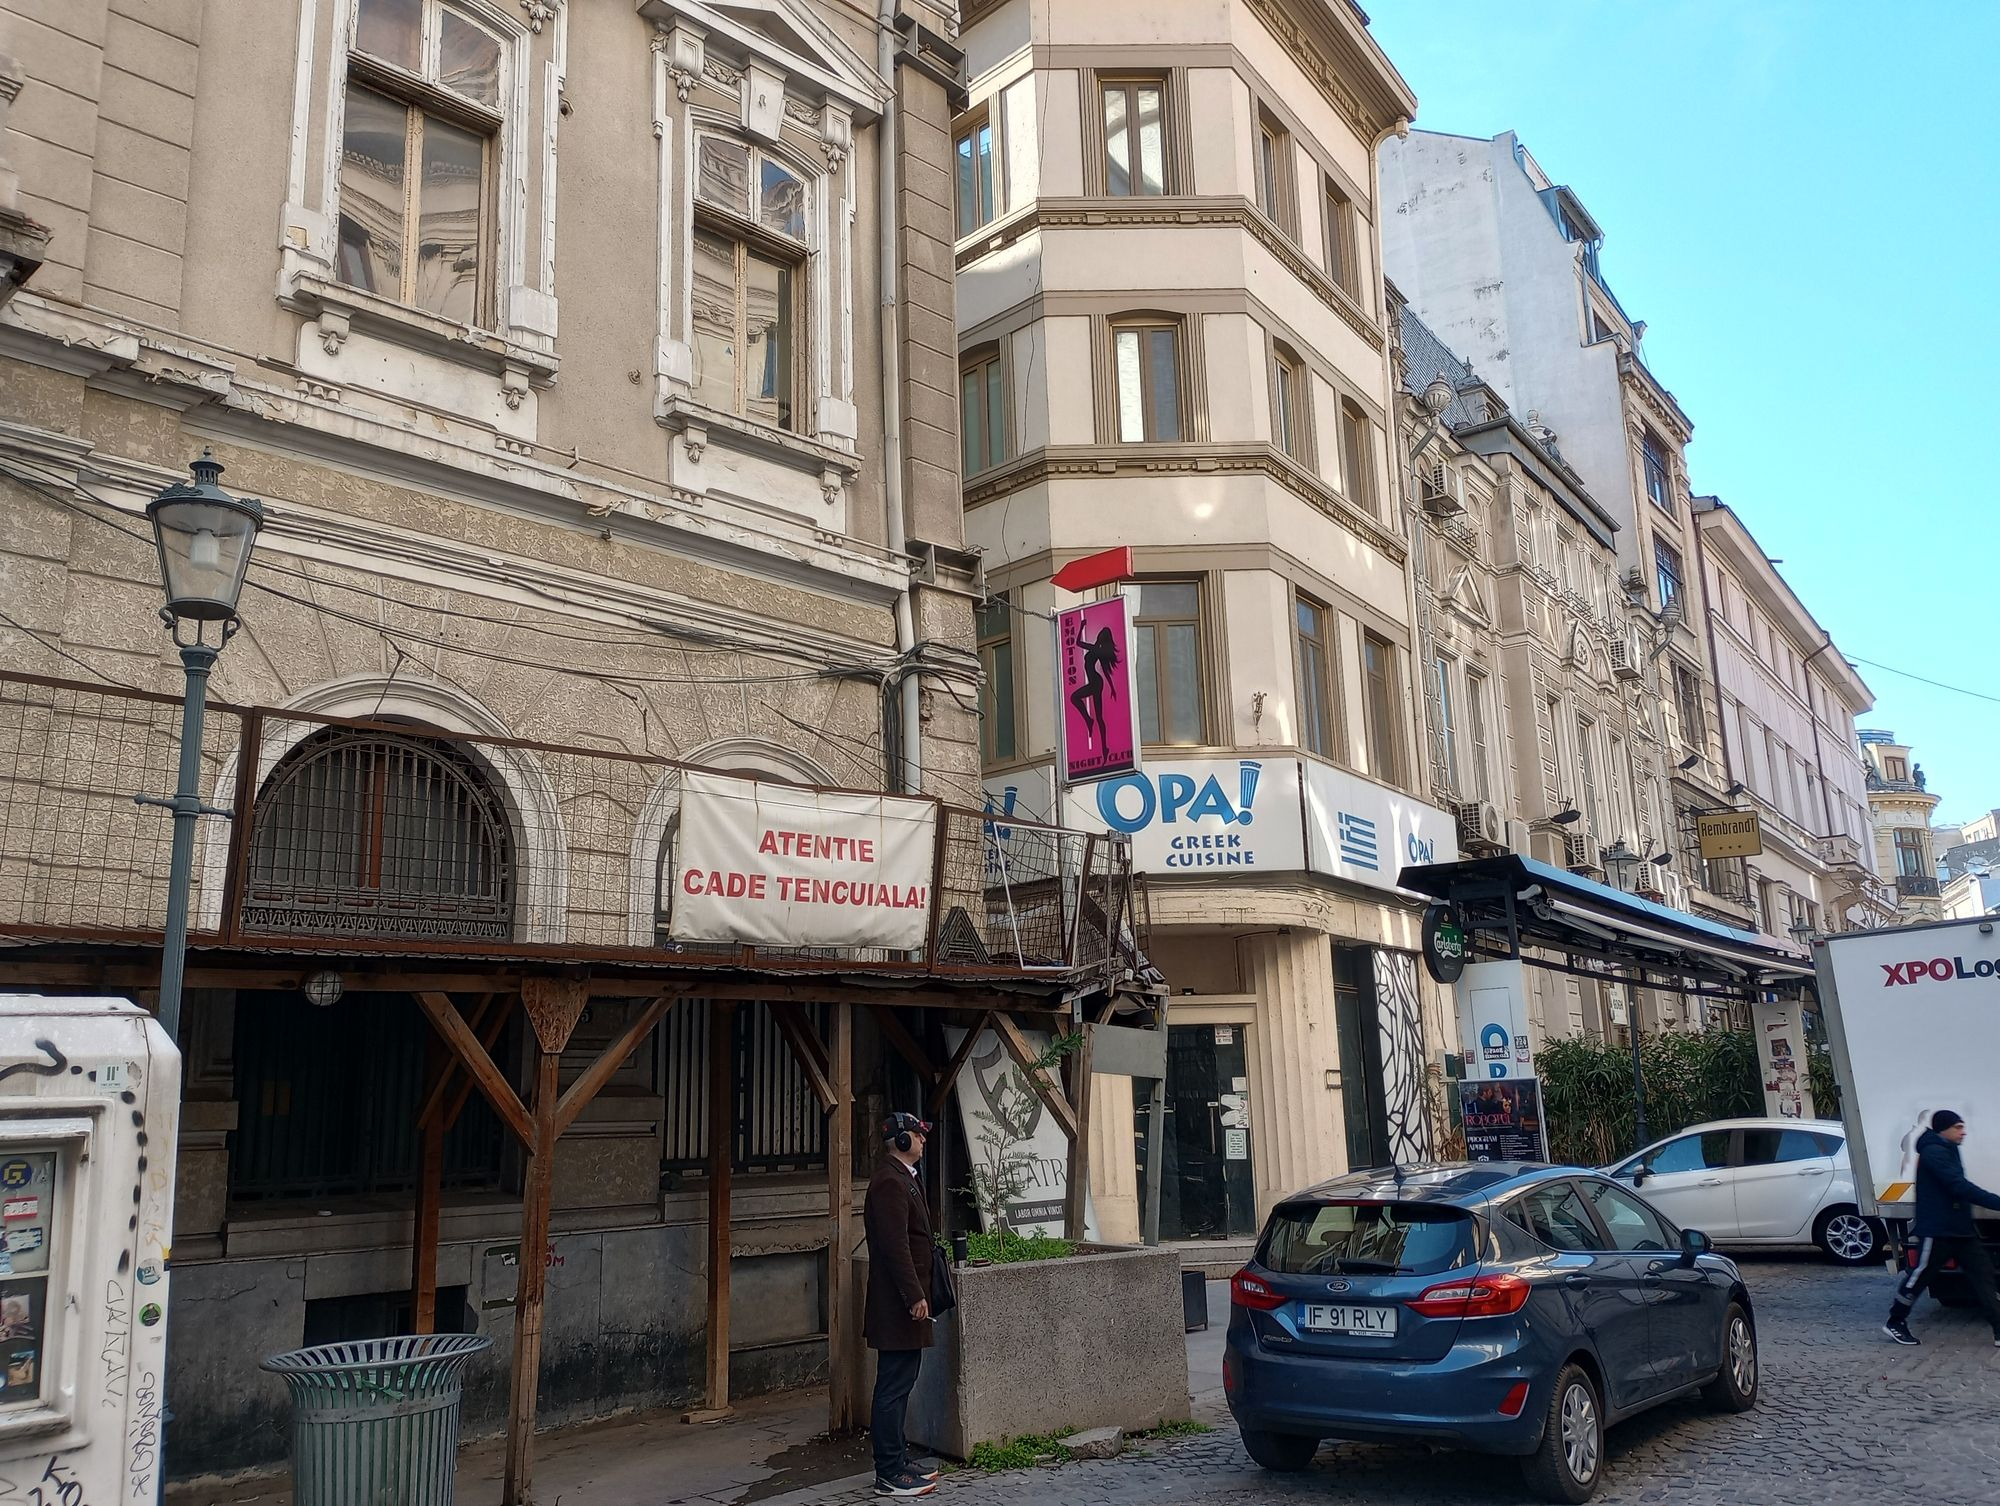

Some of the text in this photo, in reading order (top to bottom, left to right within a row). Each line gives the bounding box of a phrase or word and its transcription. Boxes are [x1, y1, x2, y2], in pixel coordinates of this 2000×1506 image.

[1065, 617, 1077, 686] EMOTION
[1069, 750, 1133, 771] NIGHT CLUB
[1096, 760, 1262, 834] OPA!
[758, 830, 874, 863] ATENTIE
[1171, 834, 1241, 850] GREEK
[1408, 832, 1434, 864] OPA!
[1166, 851, 1254, 868] CUISINE
[683, 869, 926, 909] CADE TENCUIALA!
[1434, 931, 1461, 959] Carlsberg
[1467, 1135, 1498, 1143] PROGRAM
[1015, 1205, 1063, 1219] LABOR OMNIA VINCIT
[1309, 1307, 1387, 1330] IF 91 RLY
